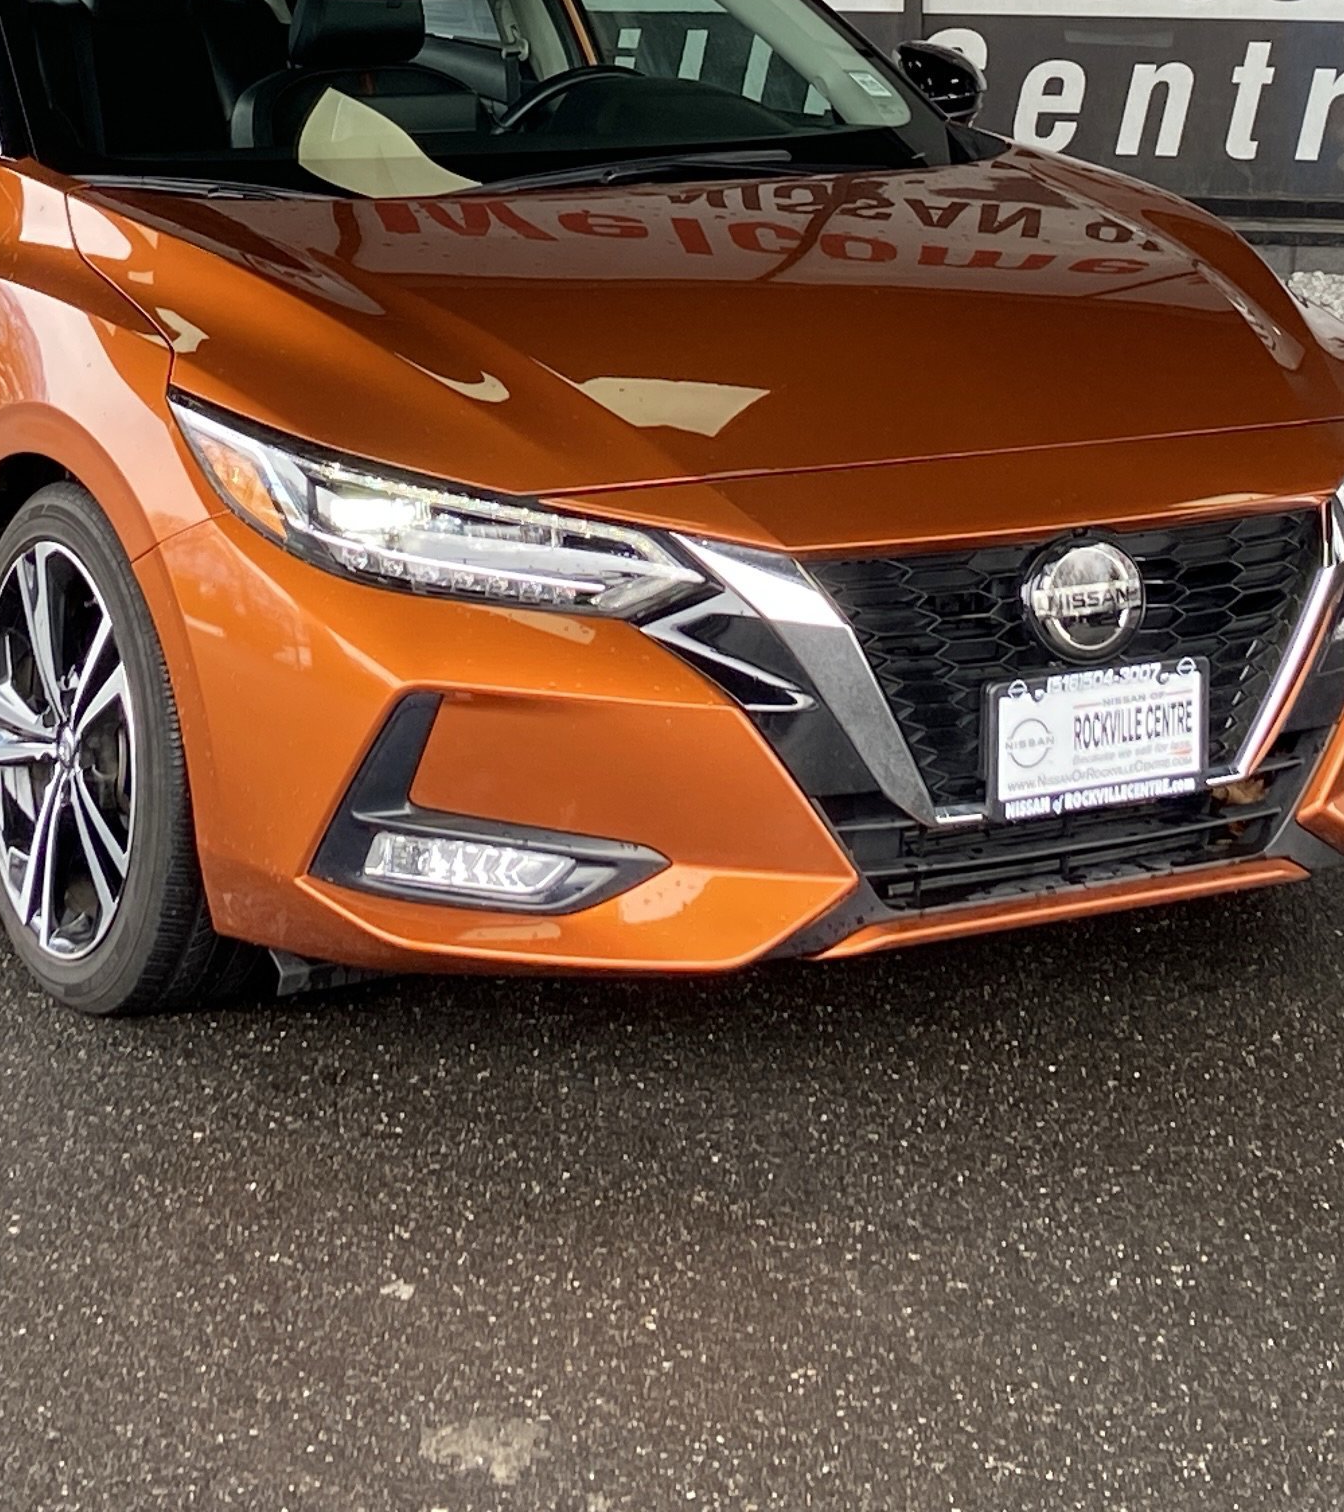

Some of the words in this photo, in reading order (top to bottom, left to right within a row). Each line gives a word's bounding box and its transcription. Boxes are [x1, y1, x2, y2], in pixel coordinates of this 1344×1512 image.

[1048, 586, 1130, 611] NISSAN
[1102, 693, 1147, 707] NISSAN
[1073, 707, 1142, 750] ROCKVILLE
[1145, 700, 1193, 740] CENTRE
[1005, 735, 1055, 751] NISSAN
[1005, 795, 1051, 820] NISSAN
